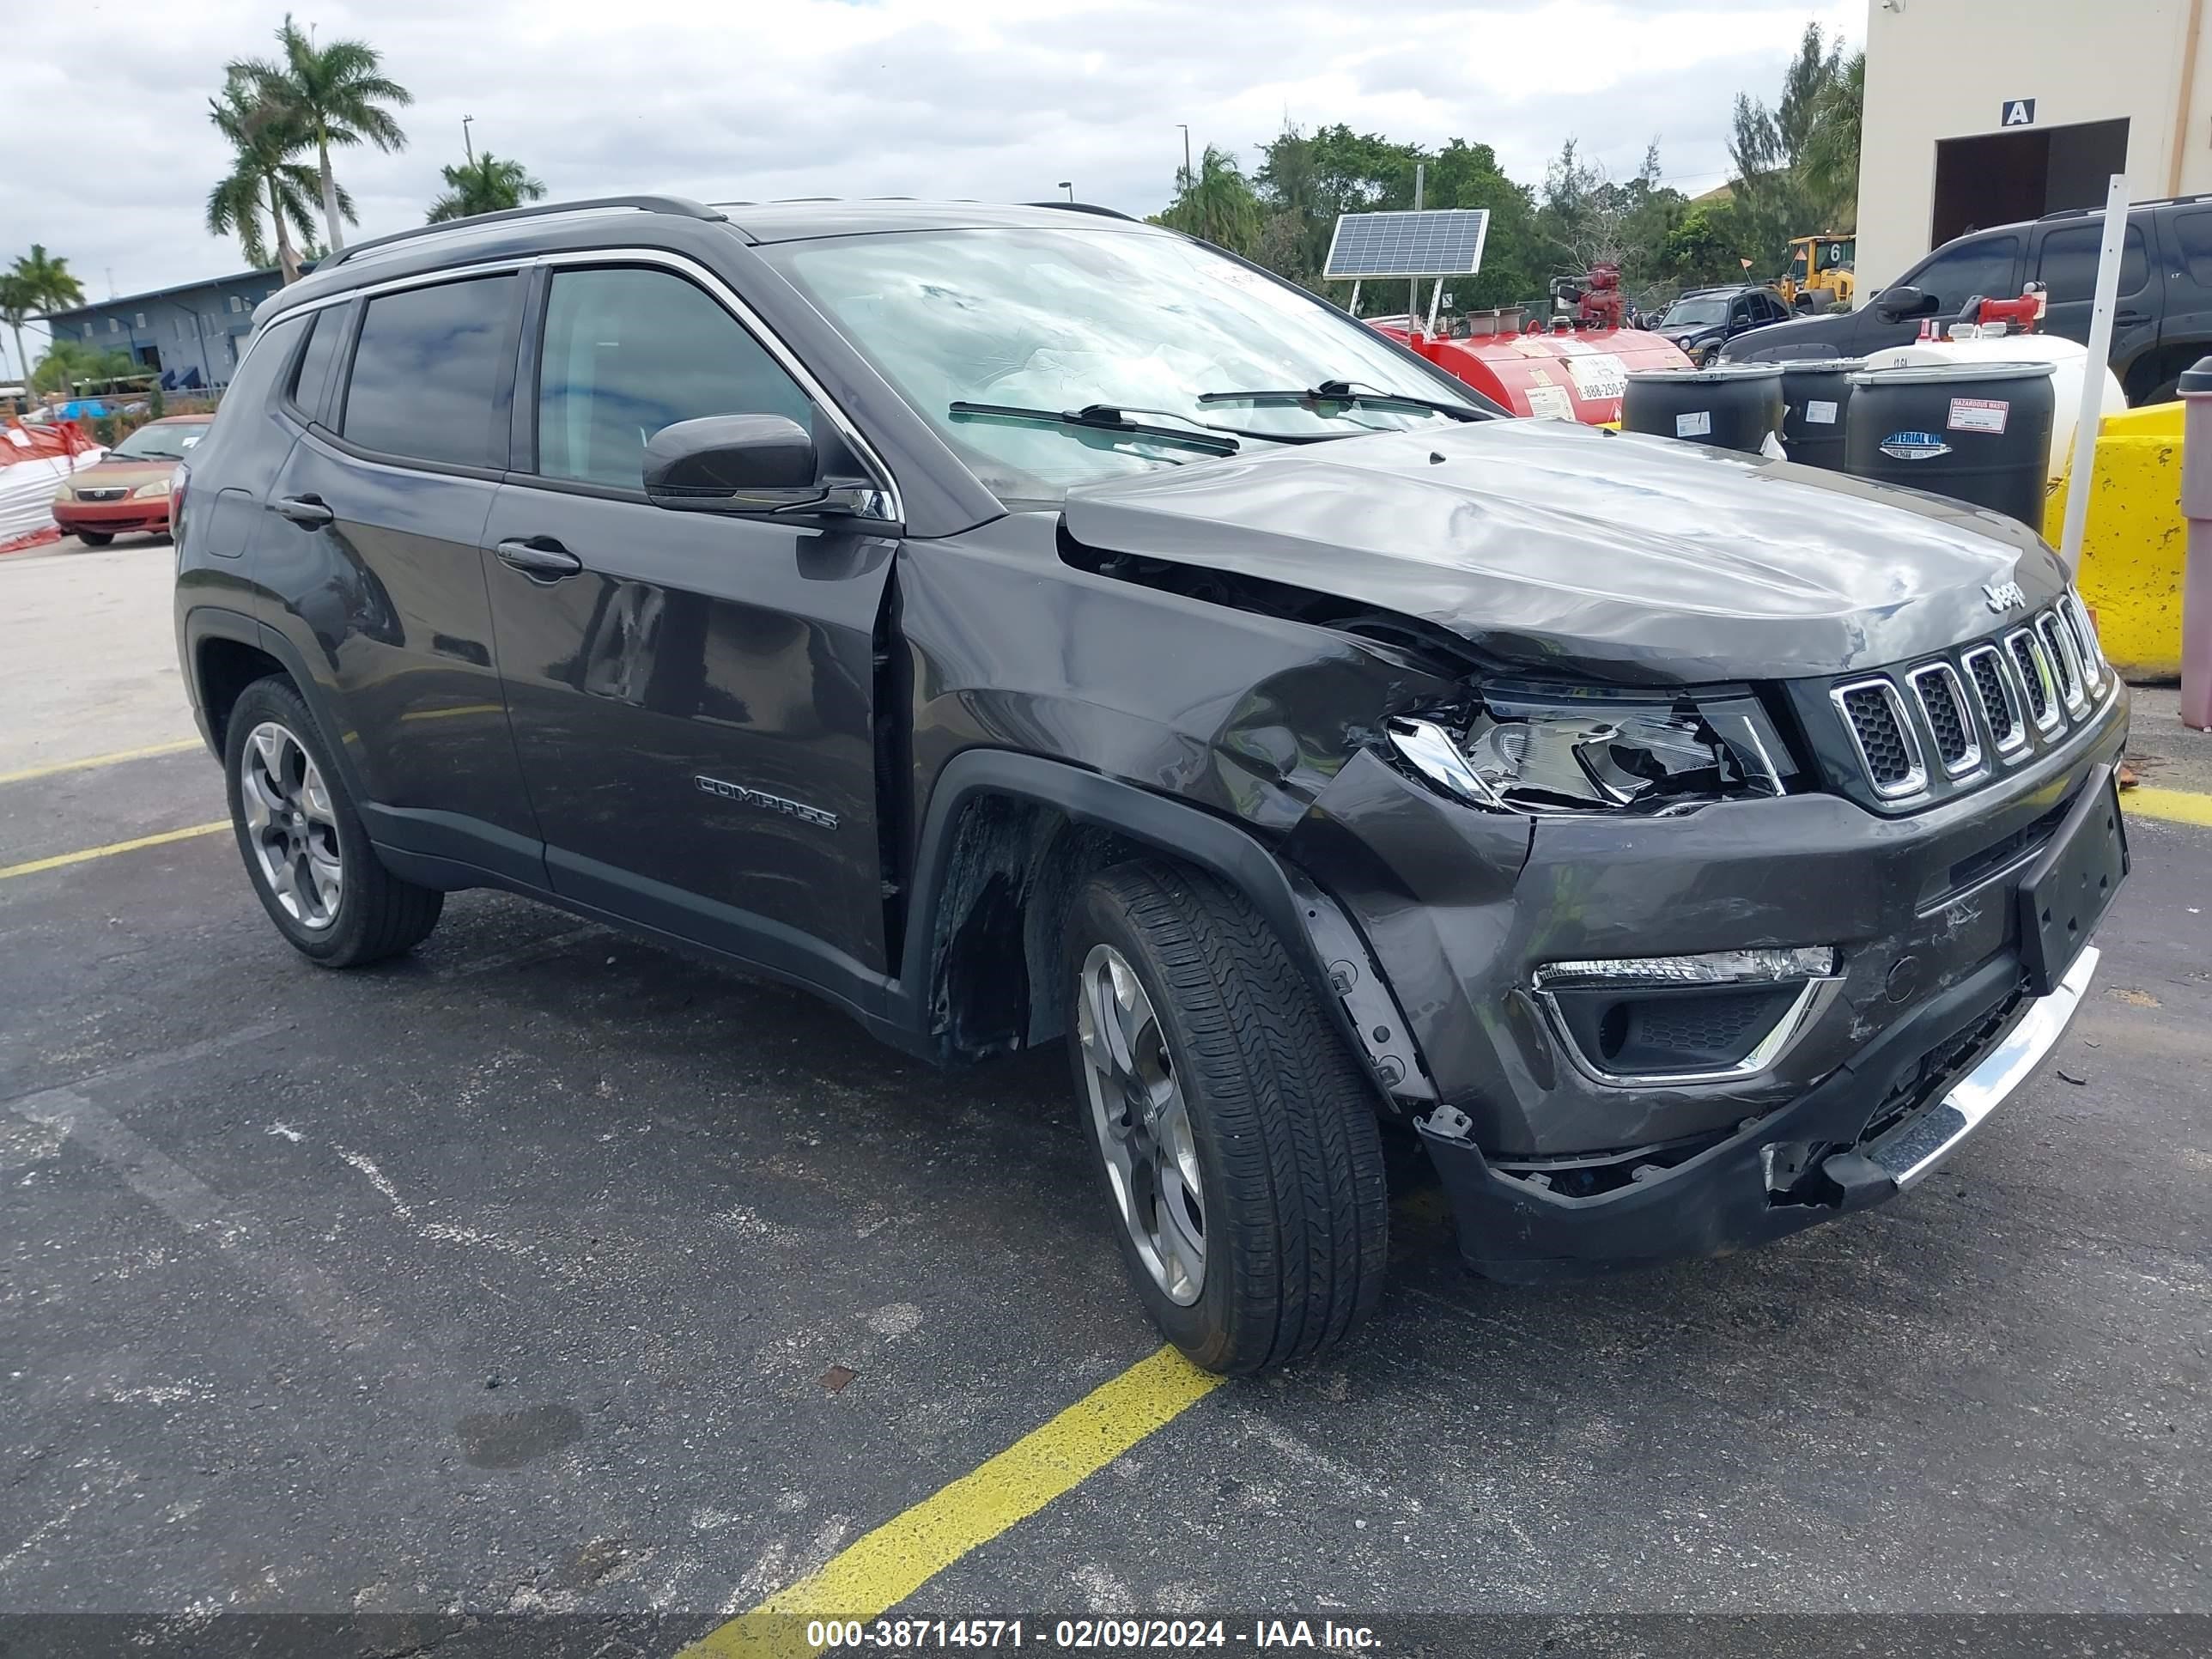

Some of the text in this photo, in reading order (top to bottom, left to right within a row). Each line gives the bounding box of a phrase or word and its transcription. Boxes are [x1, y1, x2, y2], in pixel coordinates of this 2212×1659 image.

[2007, 101, 2029, 125] A
[1830, 243, 1841, 262] 6
[1953, 399, 2007, 410] HAZARDOUS WASTE
[1981, 581, 2027, 614] Jeep
[695, 775, 839, 830] COMPASS
